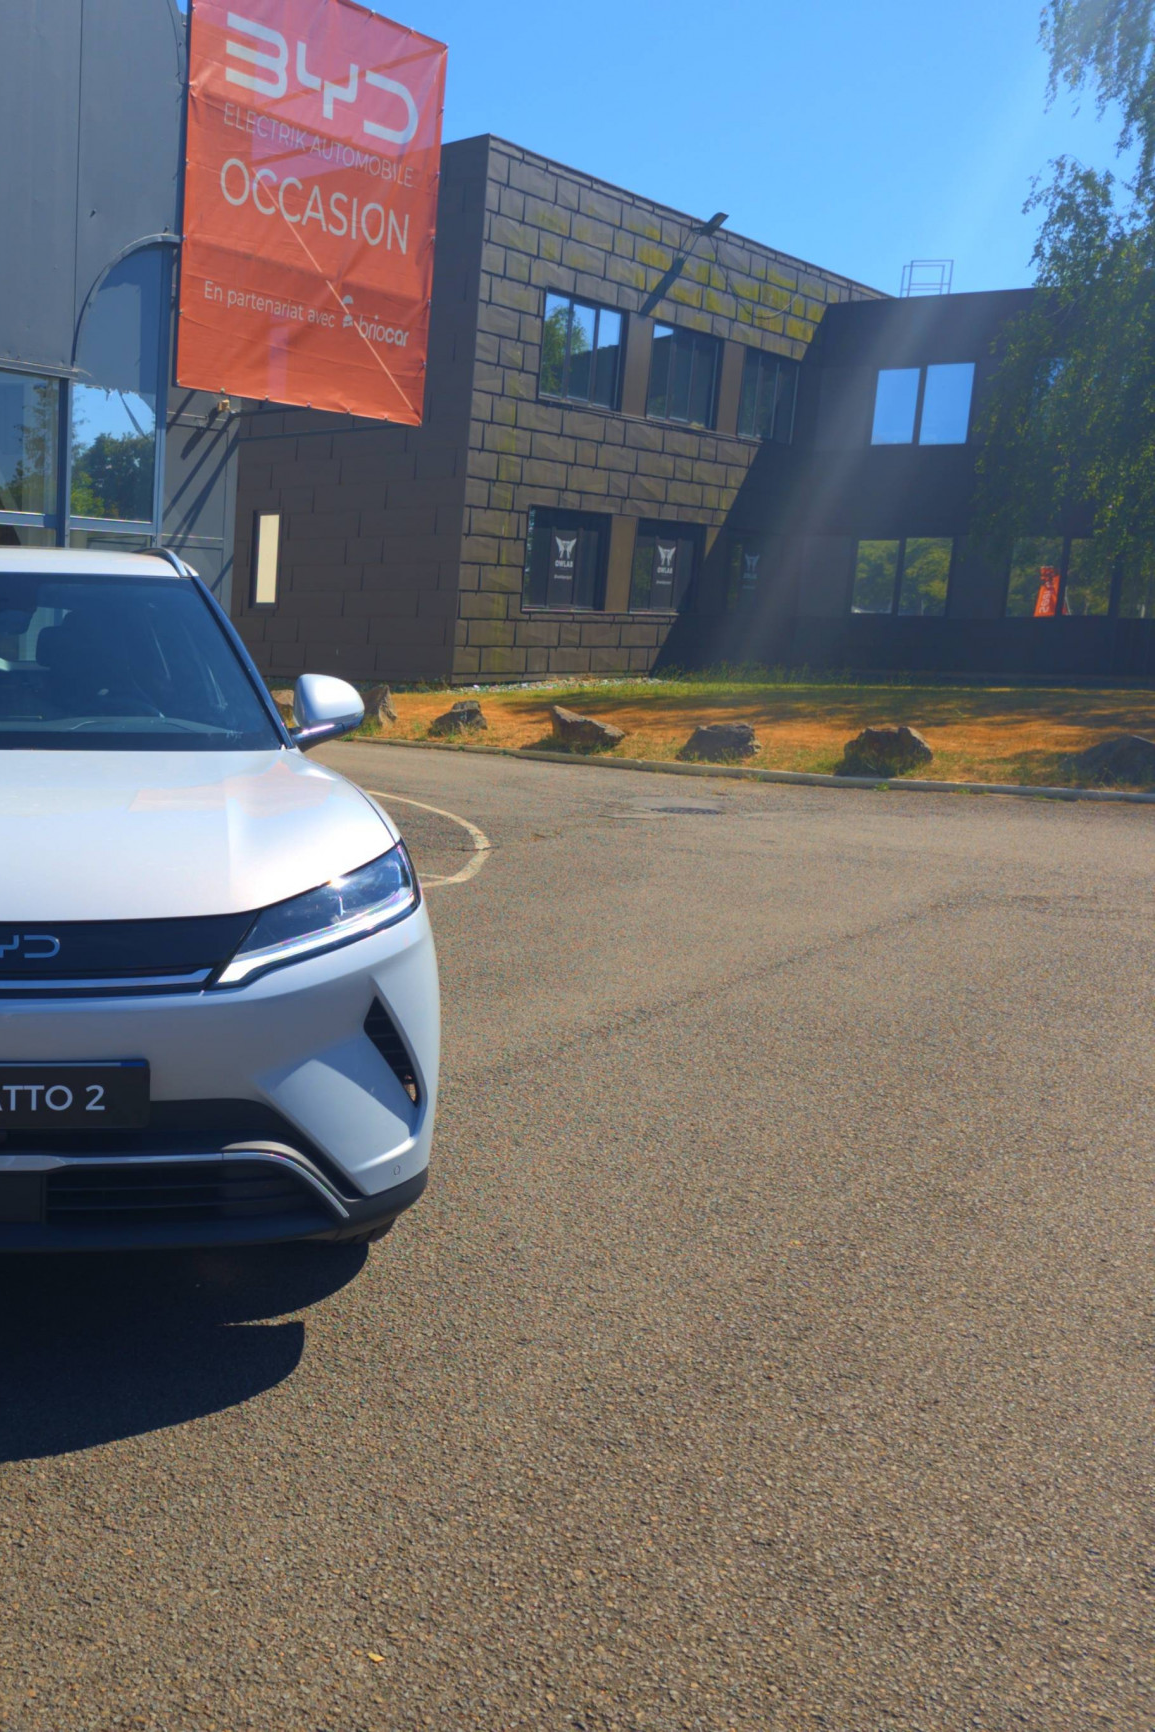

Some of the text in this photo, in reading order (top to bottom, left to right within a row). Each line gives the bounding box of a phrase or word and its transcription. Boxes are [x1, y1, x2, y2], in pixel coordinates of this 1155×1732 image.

[225, 12, 419, 145] BYD
[223, 101, 414, 188] ELECTRIK AUTOMOBILE
[220, 158, 409, 255] OCCASION
[204, 280, 410, 347] En partenariat avec briocar
[85, 1084, 106, 1111] 2
